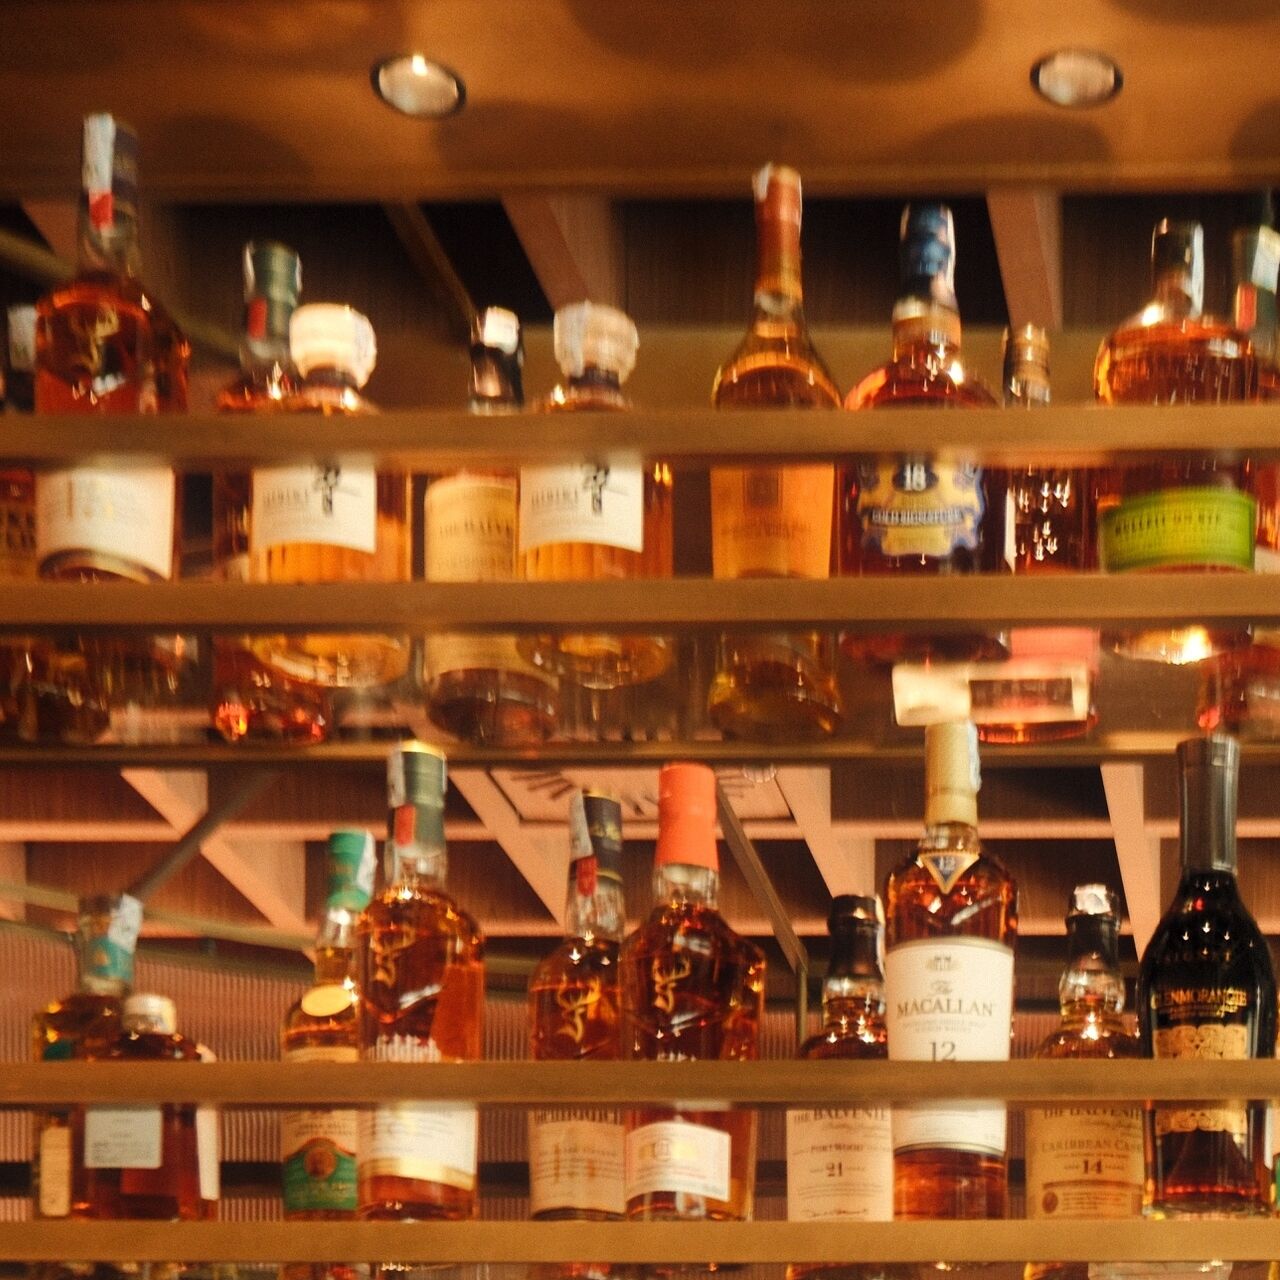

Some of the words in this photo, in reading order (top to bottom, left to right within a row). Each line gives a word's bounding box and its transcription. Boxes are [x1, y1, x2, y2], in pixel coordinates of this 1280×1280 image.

[904, 460, 926, 491] 18
[897, 998, 993, 1018] MACALLAN
[928, 1041, 957, 1061] 12
[826, 1162, 843, 1177] 21
[1083, 1160, 1102, 1174] 14
